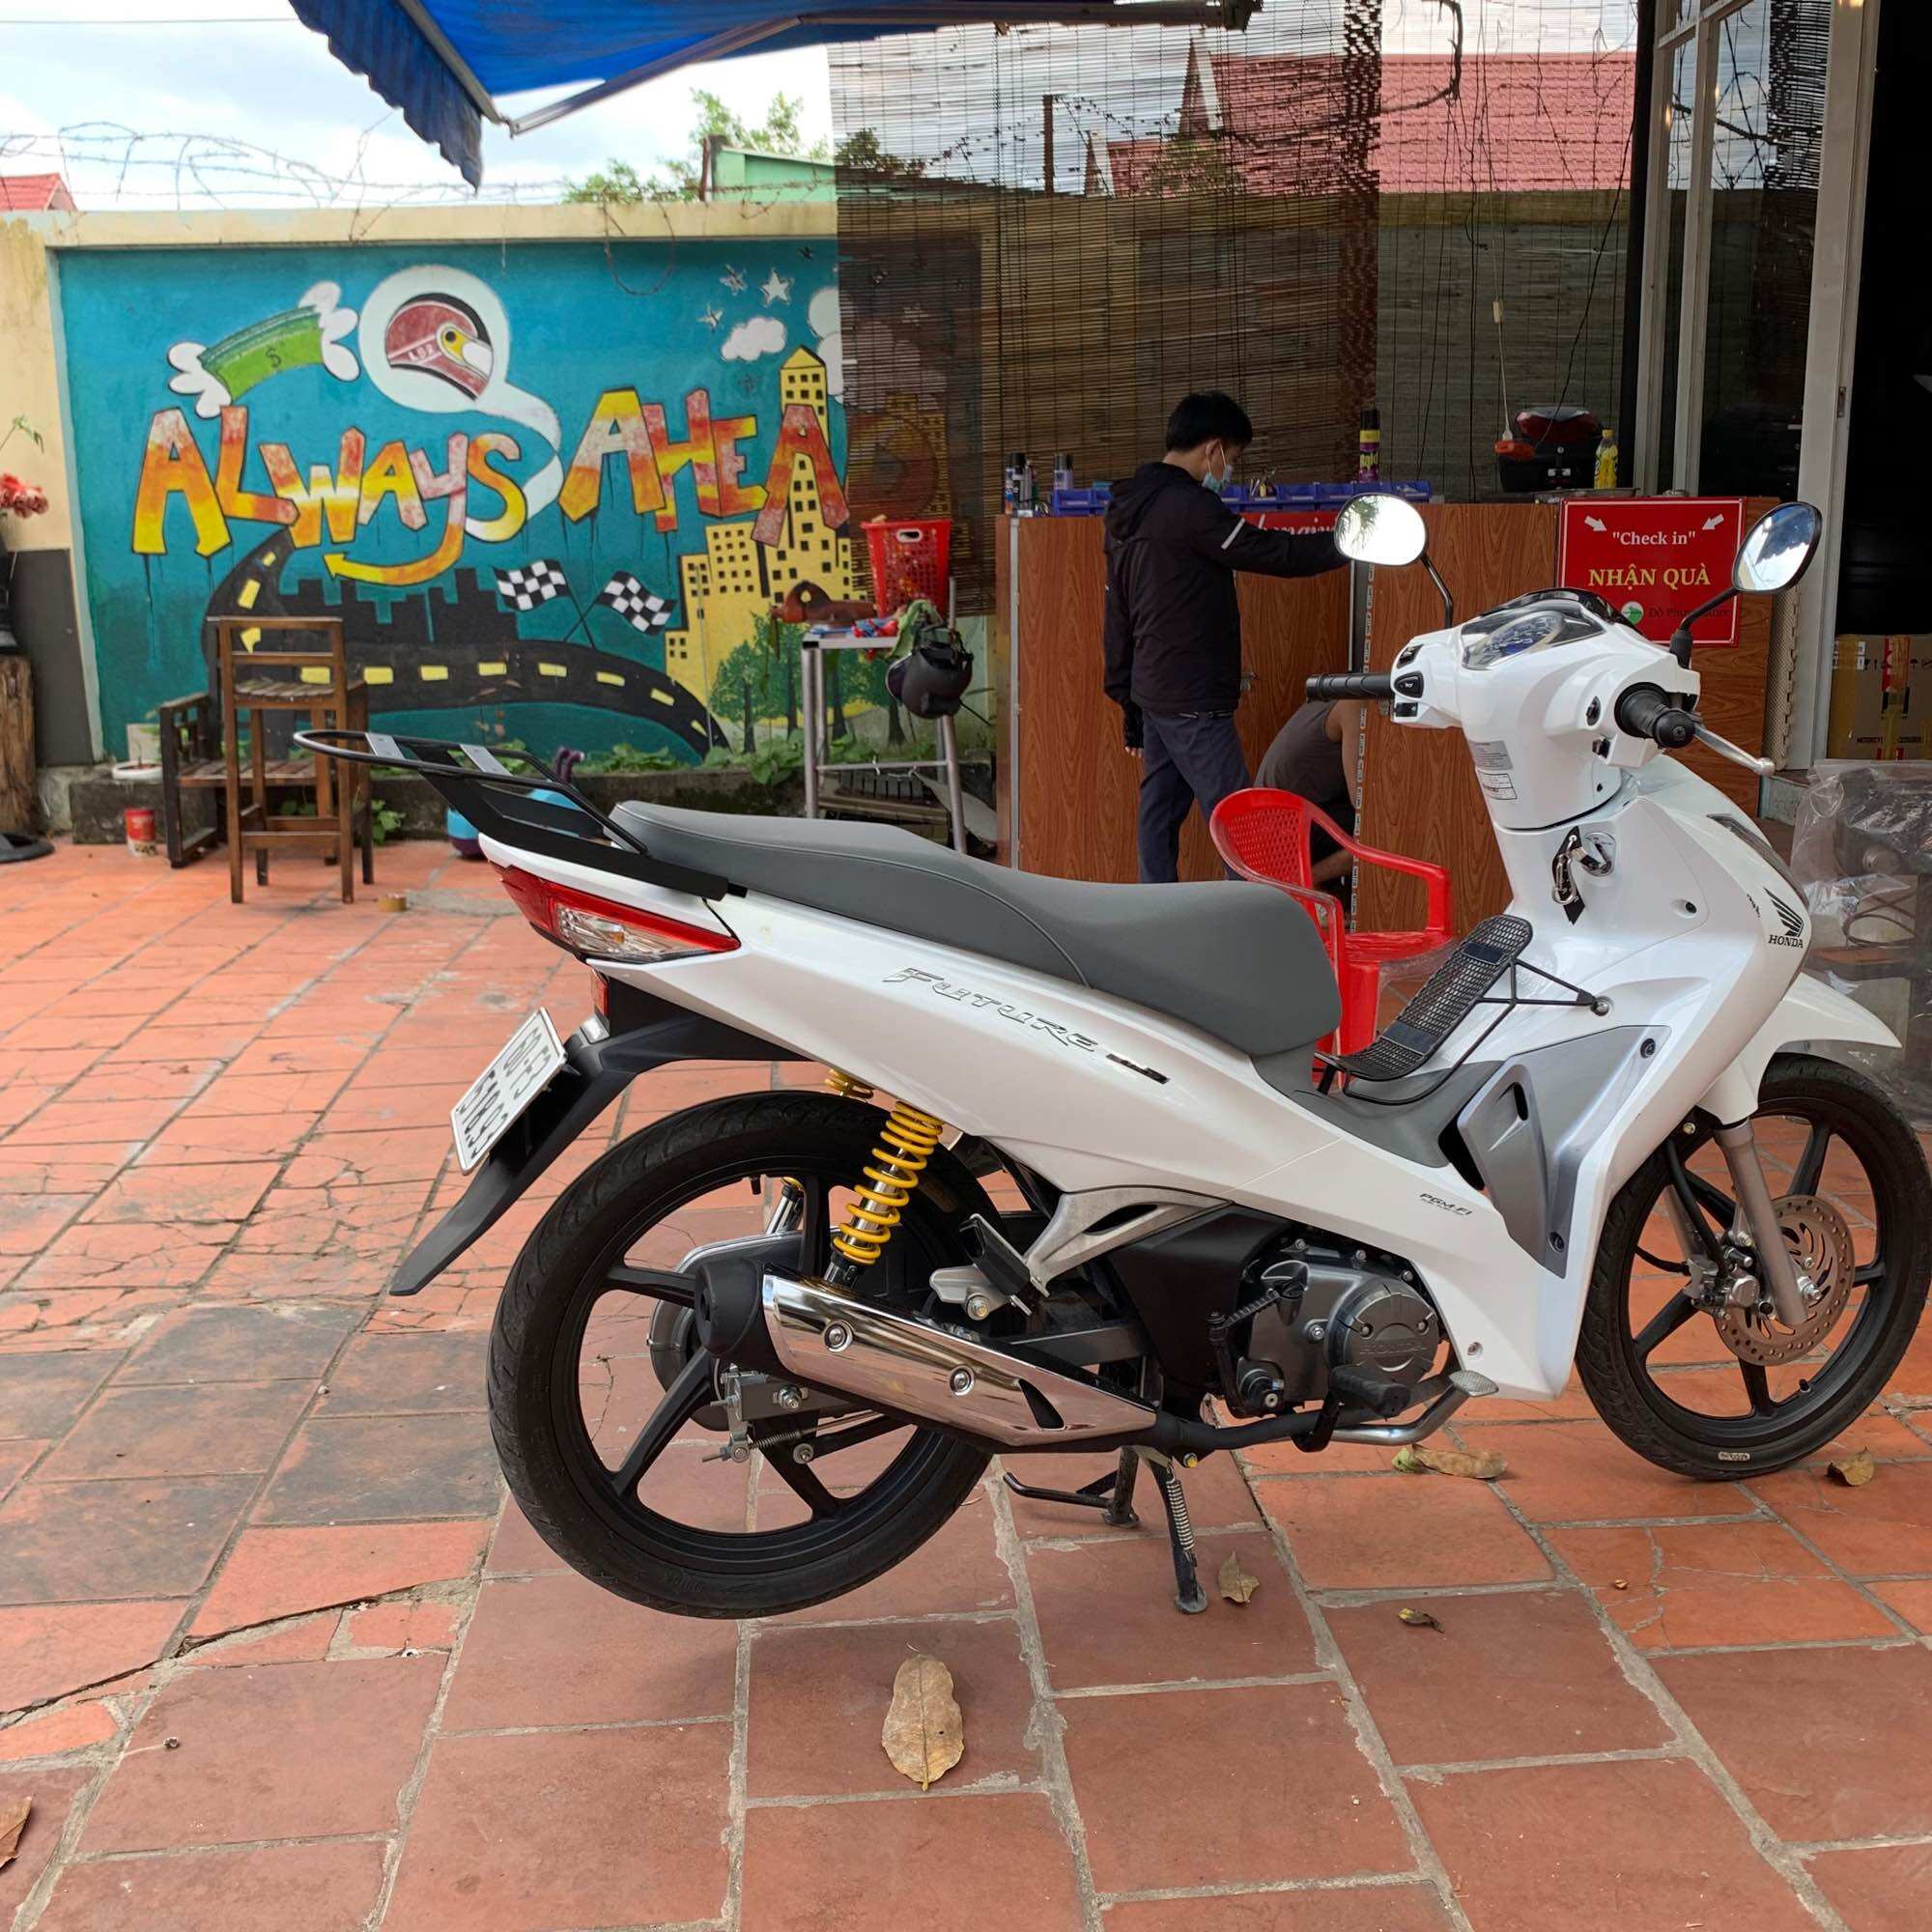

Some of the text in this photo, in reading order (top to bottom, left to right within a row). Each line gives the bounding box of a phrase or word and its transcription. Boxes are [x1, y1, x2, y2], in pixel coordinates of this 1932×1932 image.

[1612, 530, 1696, 546] "Check in"
[1588, 562, 1711, 591] NHẬN QUÀ
[1768, 934, 1804, 949] HONDA
